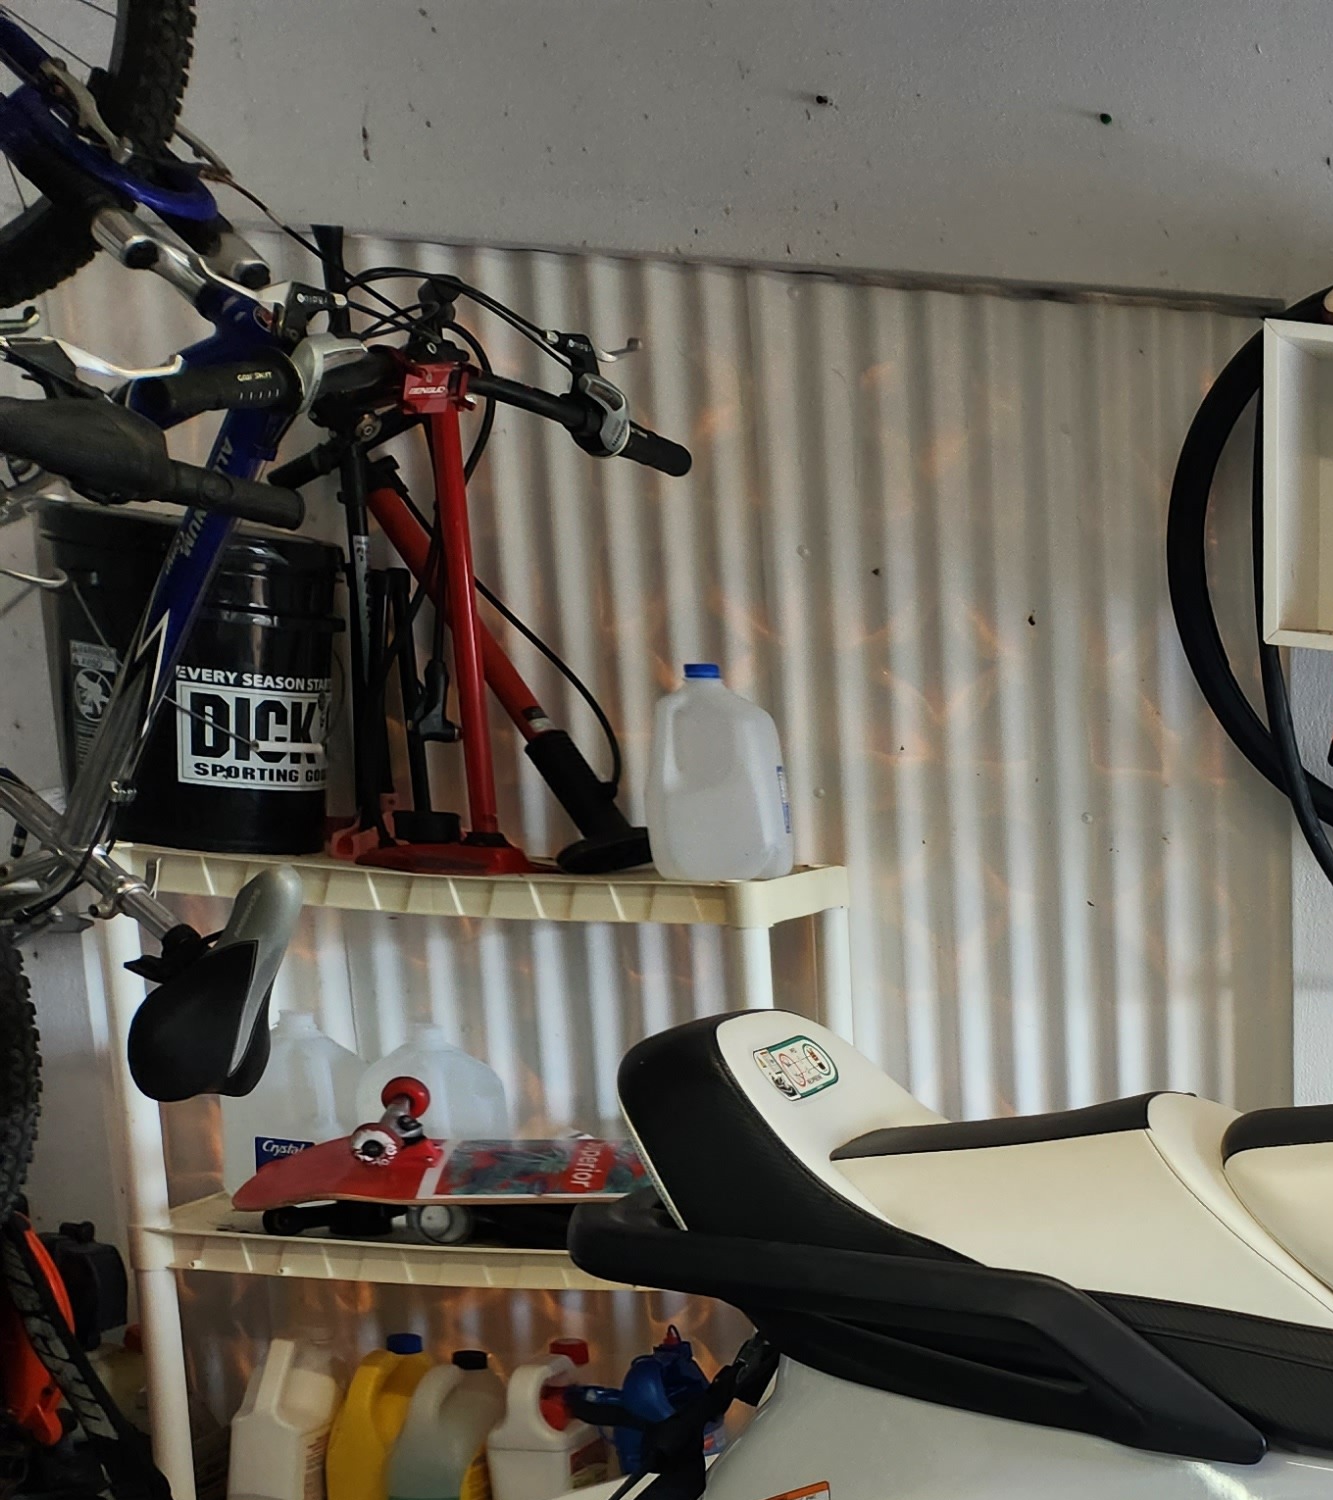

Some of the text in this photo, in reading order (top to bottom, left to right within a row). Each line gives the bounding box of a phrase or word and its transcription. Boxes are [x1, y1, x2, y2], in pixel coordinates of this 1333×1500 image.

[175, 665, 238, 685] EVERY
[242, 673, 305, 690] SEASON
[190, 692, 331, 764] DICK
[194, 762, 299, 783] SPORTING
[262, 1140, 305, 1156] Crystal
